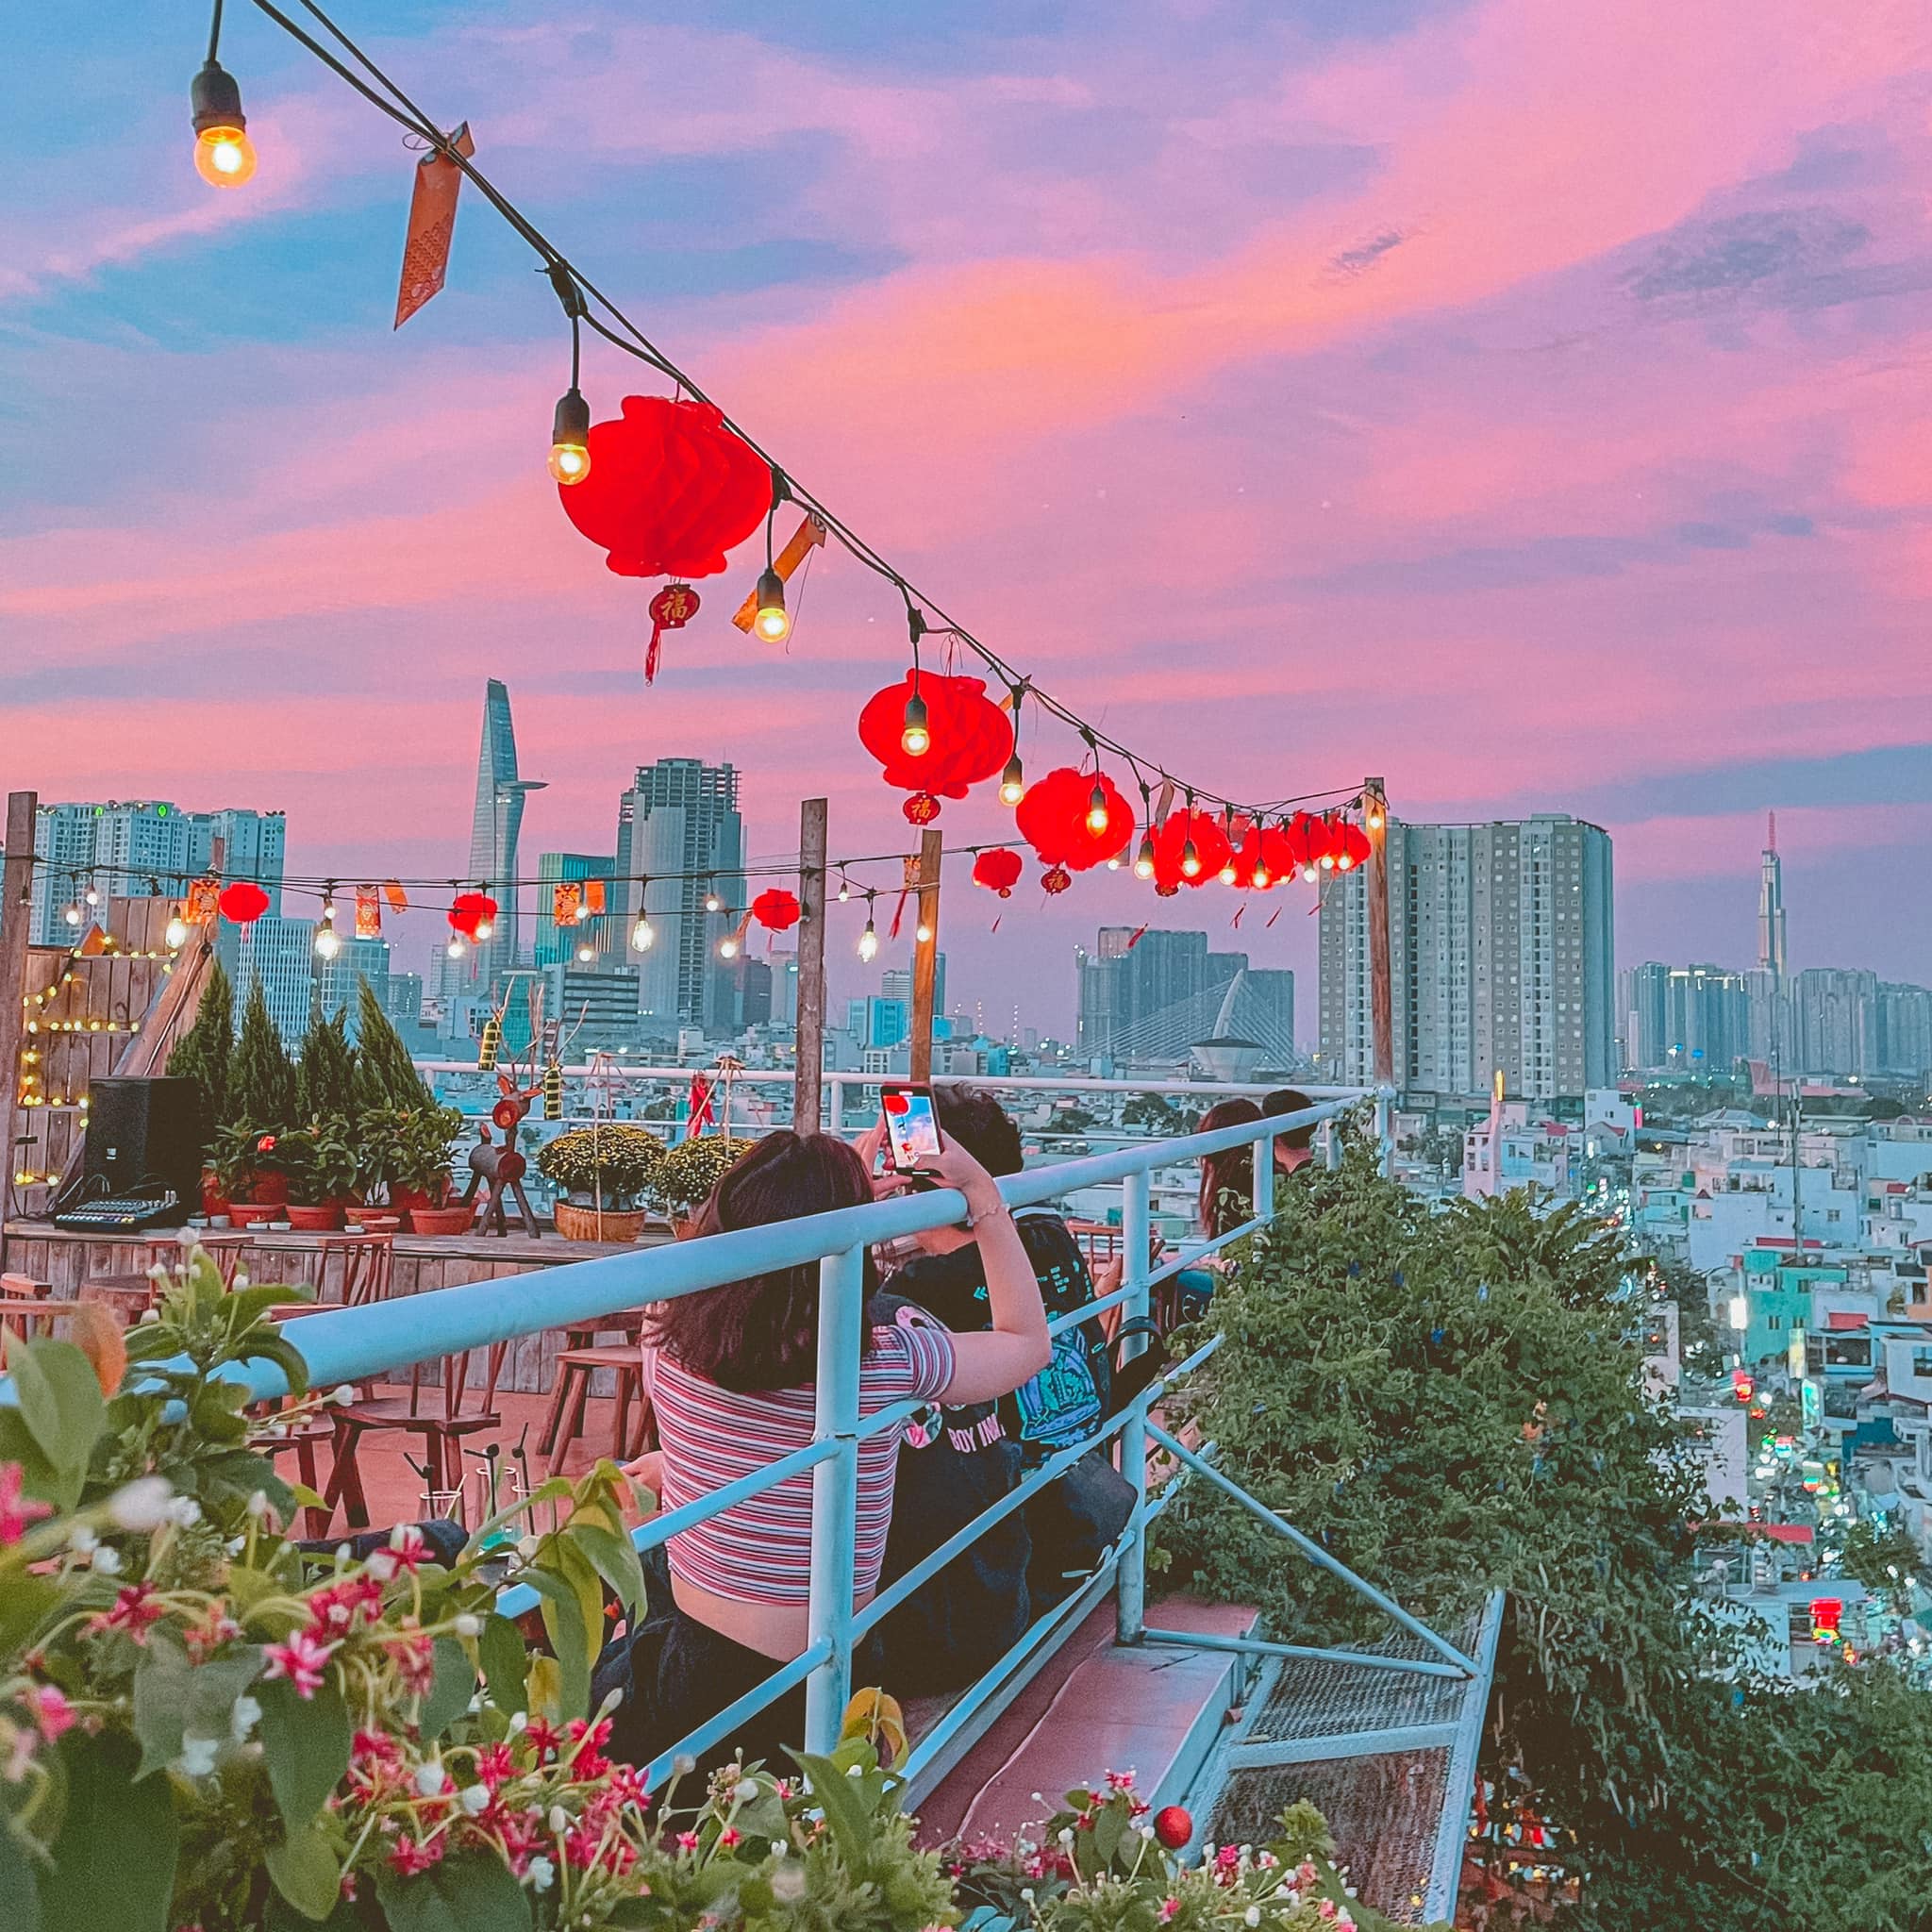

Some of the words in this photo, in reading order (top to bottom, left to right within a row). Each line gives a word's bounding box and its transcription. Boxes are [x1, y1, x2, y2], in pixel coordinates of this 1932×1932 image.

[660, 591, 688, 621] 福
[911, 798, 931, 819] 福
[946, 1426, 977, 1454] BOY
